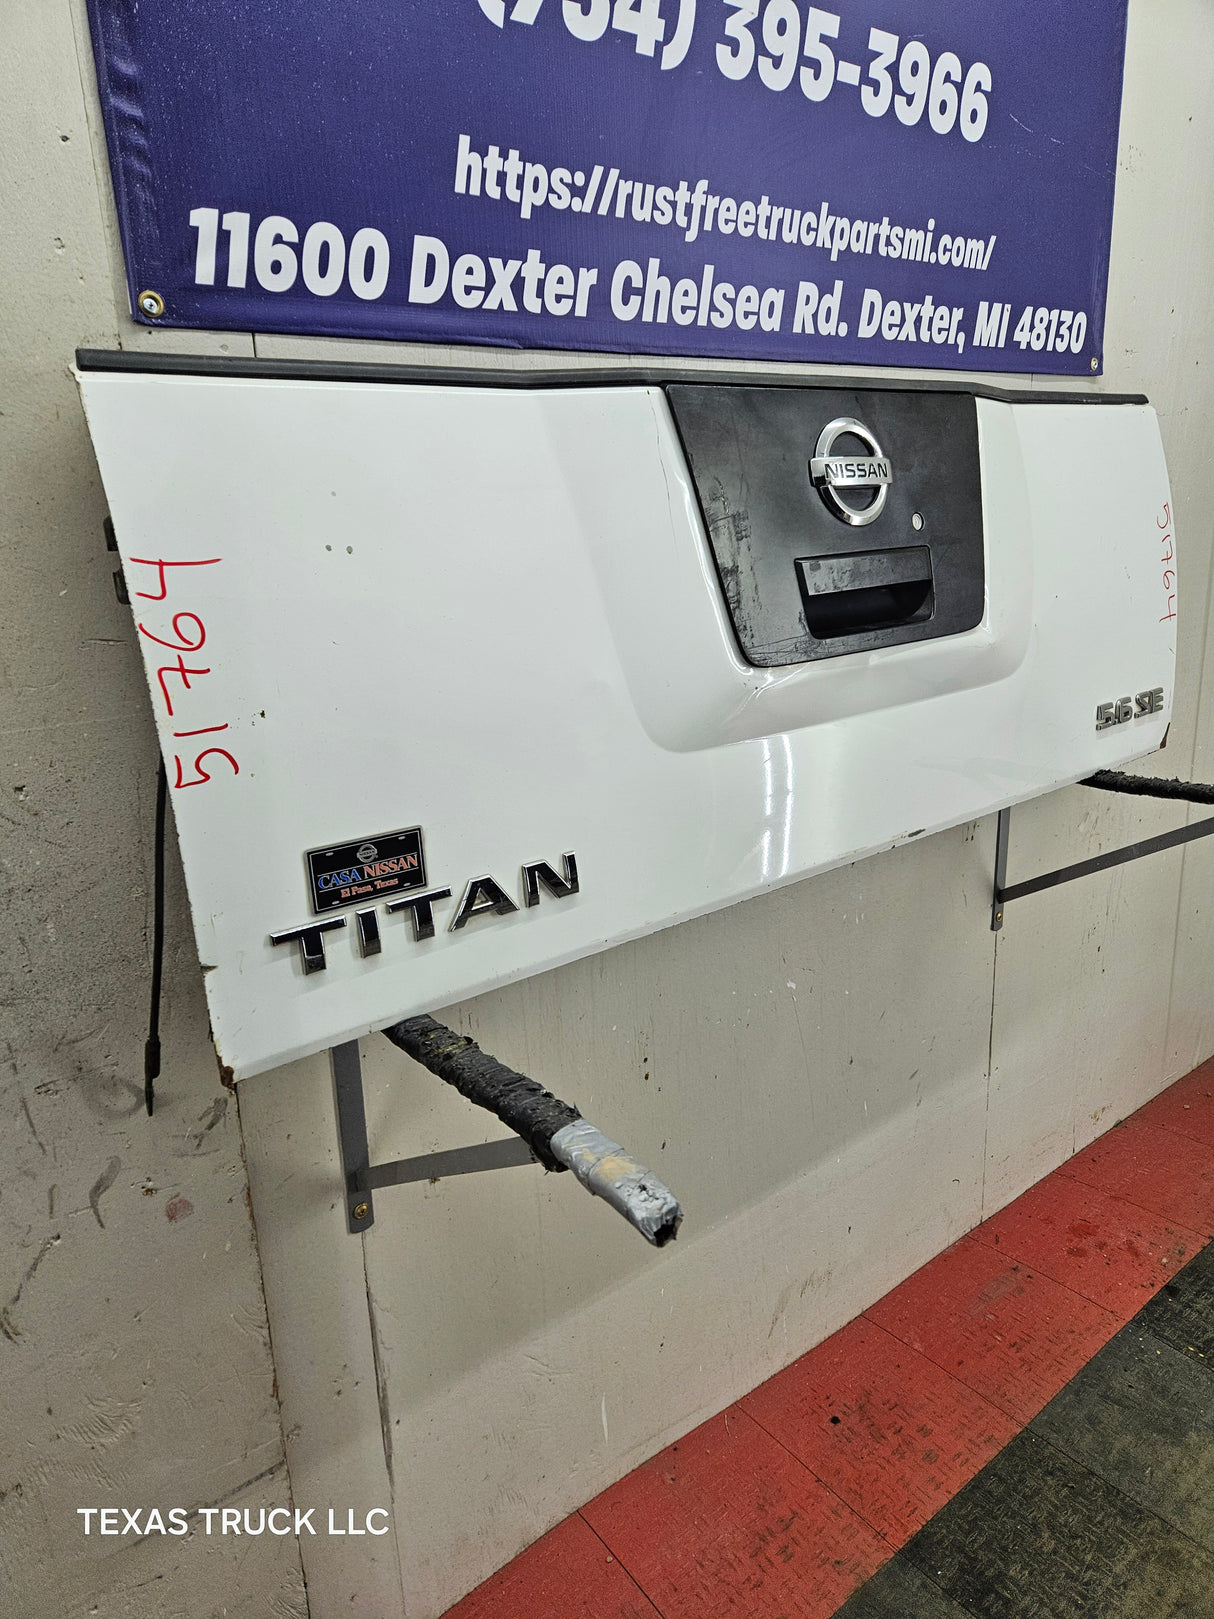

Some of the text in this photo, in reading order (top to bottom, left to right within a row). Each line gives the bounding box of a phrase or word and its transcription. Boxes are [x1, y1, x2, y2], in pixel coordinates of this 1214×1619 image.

[715, 0, 992, 142] 395-3966
[454, 134, 996, 271] https://rustfreetruckpartsmi.com/
[189, 207, 1087, 354] 11600 Dexter Chelsea Rd. Dexter, MI 48130
[824, 462, 888, 479] NISSAN
[1156, 501, 1177, 623] 51764
[129, 557, 239, 789] 51764
[1134, 687, 1164, 719] SE
[270, 851, 580, 975] TITAN
[318, 854, 419, 889] CASA NISSAN
[340, 887, 351, 898] El
[374, 878, 399, 889] Texas
